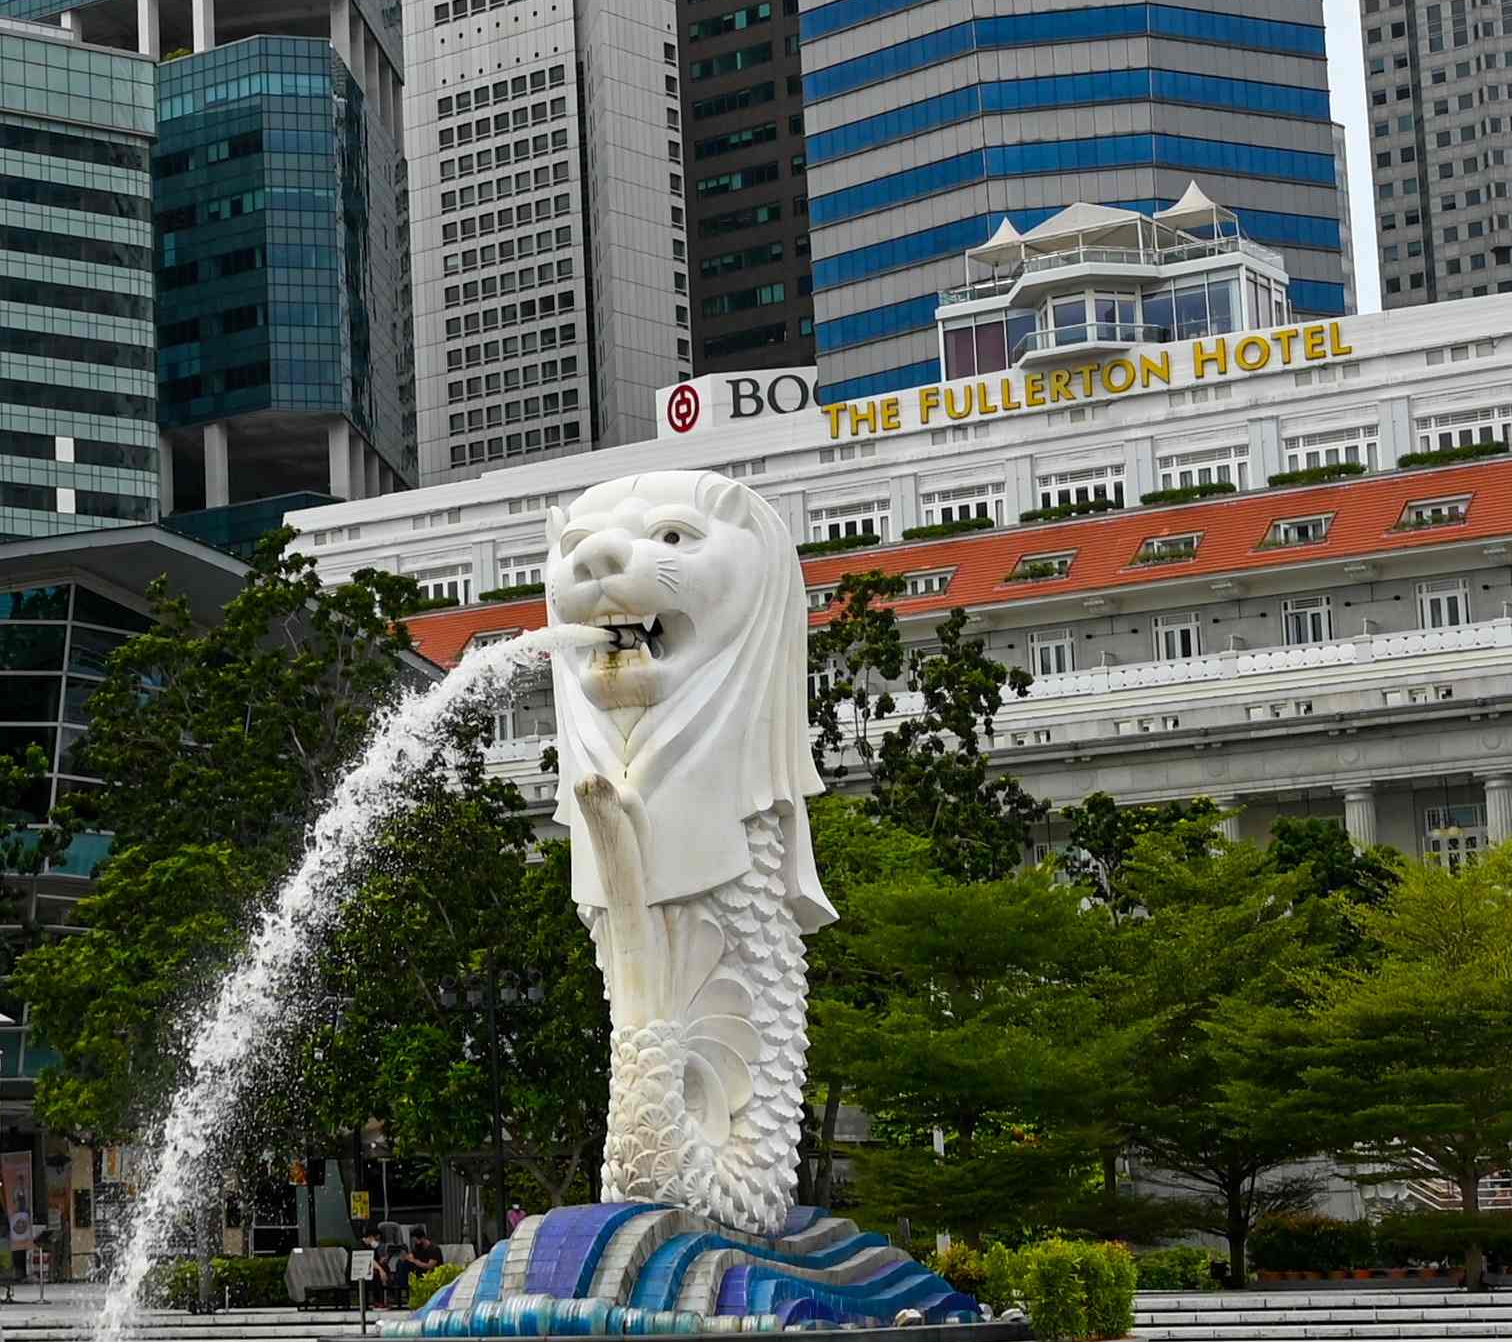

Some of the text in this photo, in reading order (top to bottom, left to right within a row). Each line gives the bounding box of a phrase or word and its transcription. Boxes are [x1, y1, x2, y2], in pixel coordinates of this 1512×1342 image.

[725, 373, 820, 420] BO
[821, 321, 1353, 440] THE FULLERTON HOTEL
